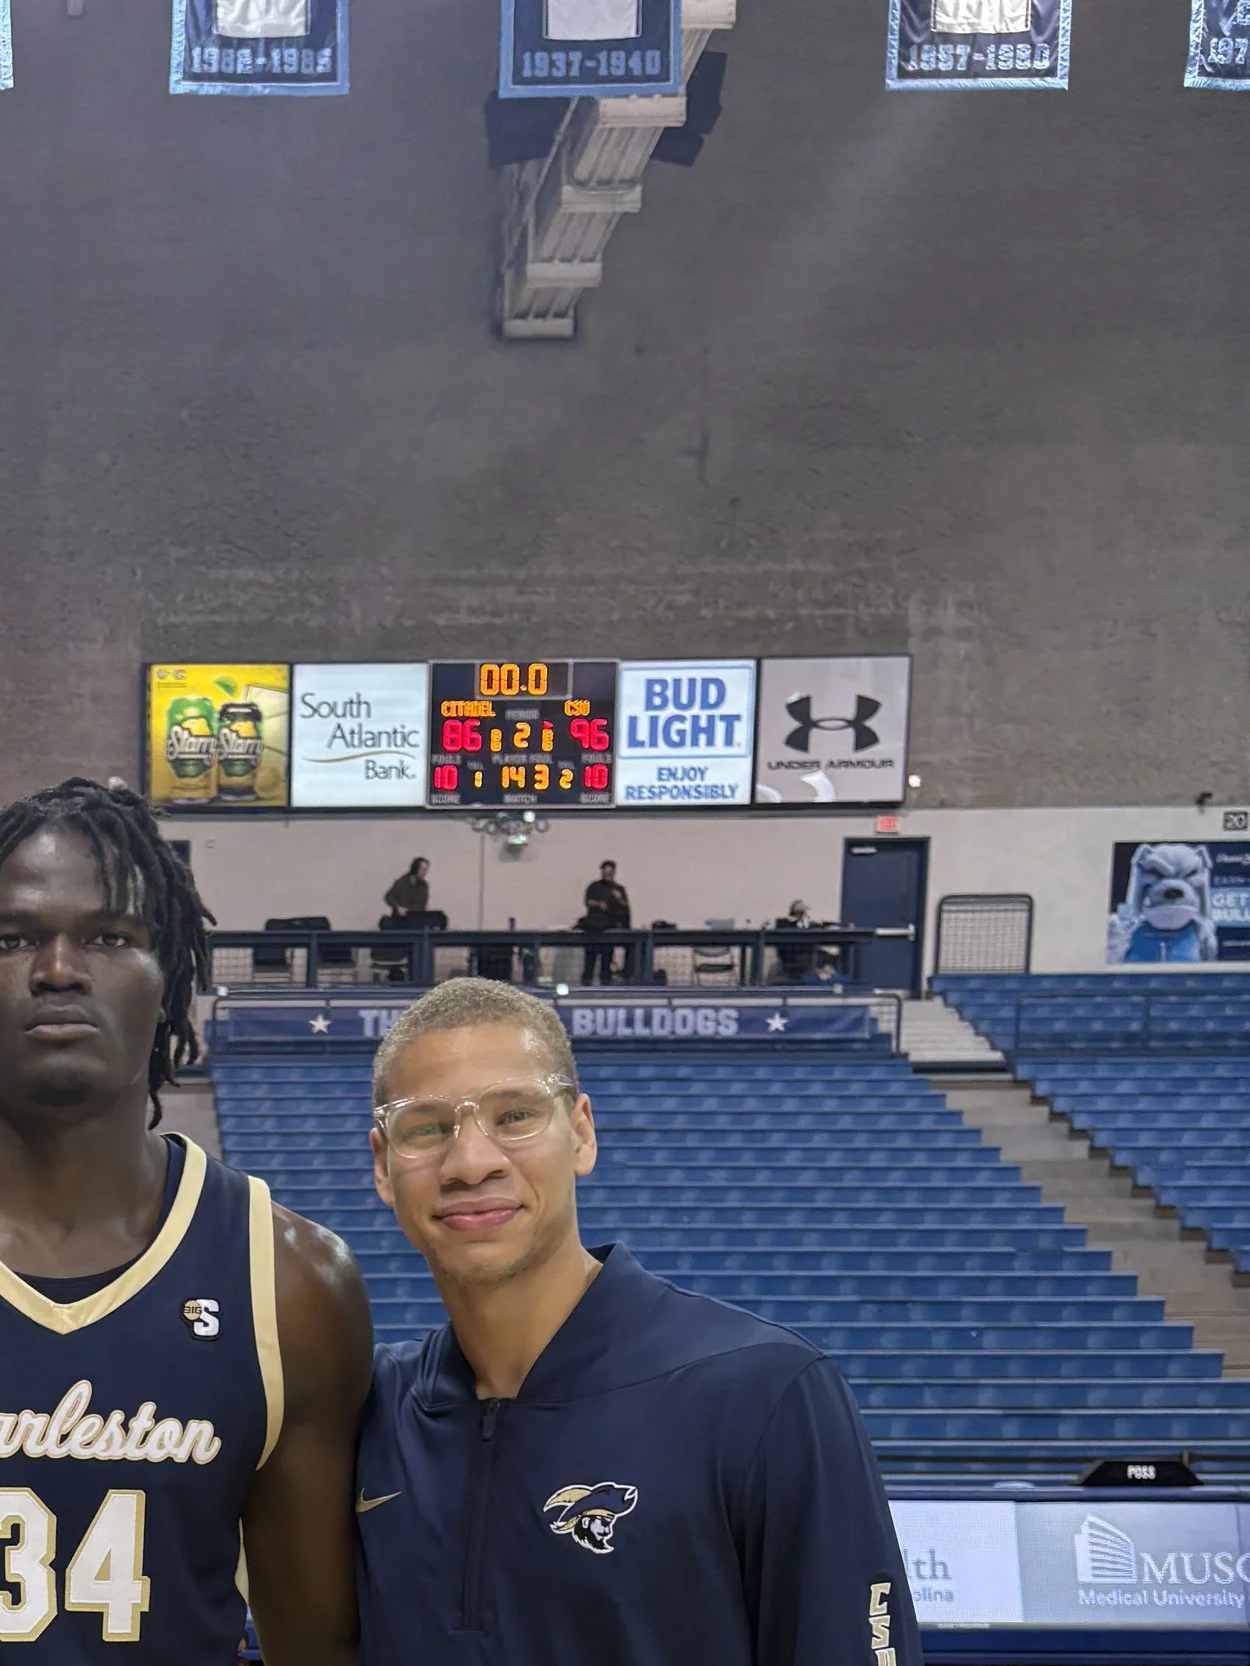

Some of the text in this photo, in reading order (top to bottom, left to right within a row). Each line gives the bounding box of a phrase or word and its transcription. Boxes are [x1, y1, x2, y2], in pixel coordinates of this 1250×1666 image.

[522, 50, 661, 78] 1937-1940
[480, 663, 547, 696] 00.0
[300, 692, 372, 718] South
[644, 677, 727, 711] BUD
[440, 700, 496, 717] CITADEL
[564, 700, 590, 716] CSU
[327, 722, 420, 748] Atlantic
[442, 718, 482, 752] 86
[513, 722, 531, 748] 2
[570, 718, 609, 751] 96
[627, 714, 742, 748] LIGHT
[365, 760, 412, 780] Bank
[433, 765, 458, 791] 10
[502, 765, 525, 789] 14
[534, 763, 549, 790] 3
[584, 763, 608, 791] 10
[657, 767, 708, 781] ENJOY
[767, 760, 895, 770] UNDER ARMOUR
[474, 770, 483, 788] 1
[559, 768, 573, 790] 2
[624, 784, 739, 800] RESPONSIBLY
[572, 1008, 739, 1037] BULLDOGS
[1079, 1588, 1245, 1609] Medical University
